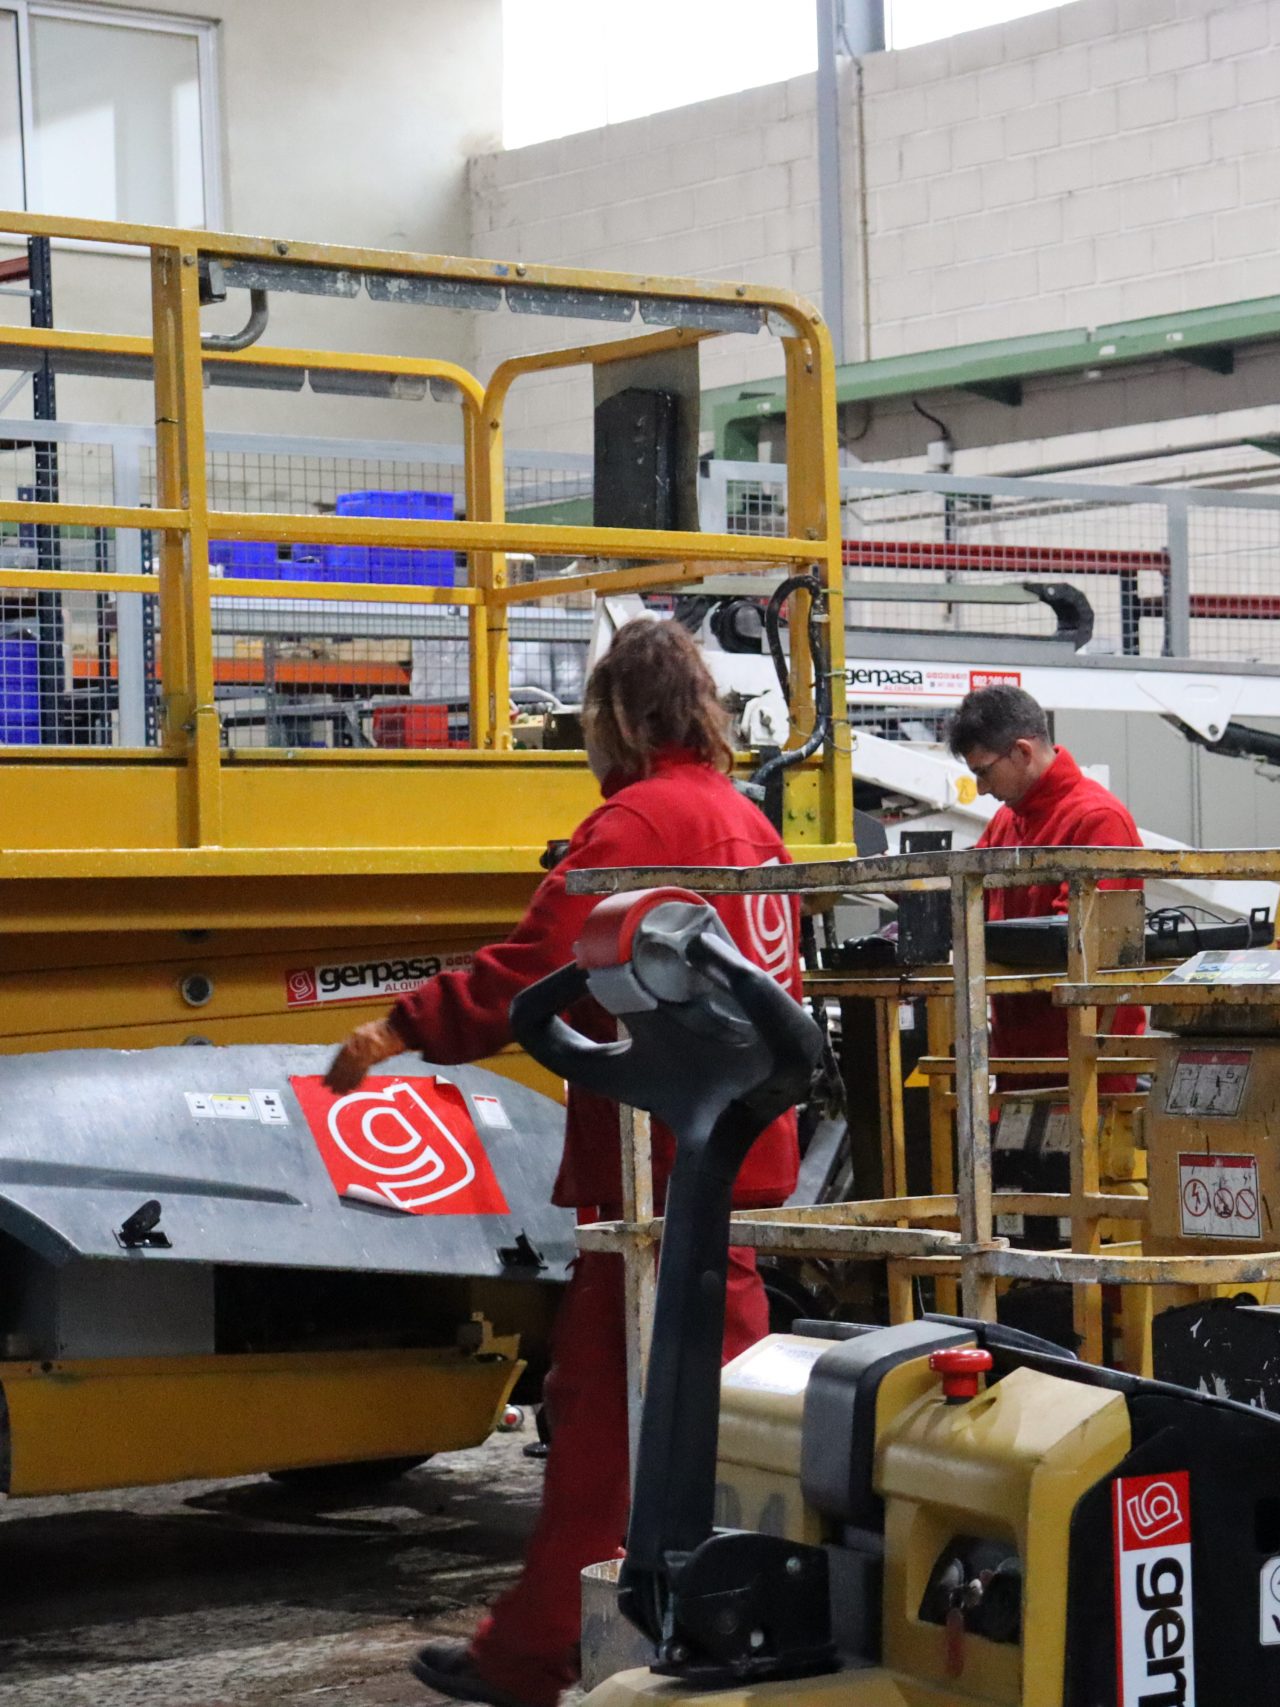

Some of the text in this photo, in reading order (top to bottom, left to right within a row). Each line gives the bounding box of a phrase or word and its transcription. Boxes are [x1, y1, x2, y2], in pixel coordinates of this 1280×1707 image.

[845, 668, 923, 687] gerpasa
[319, 956, 441, 993] gerpasa
[1136, 1557, 1187, 1707] ger
